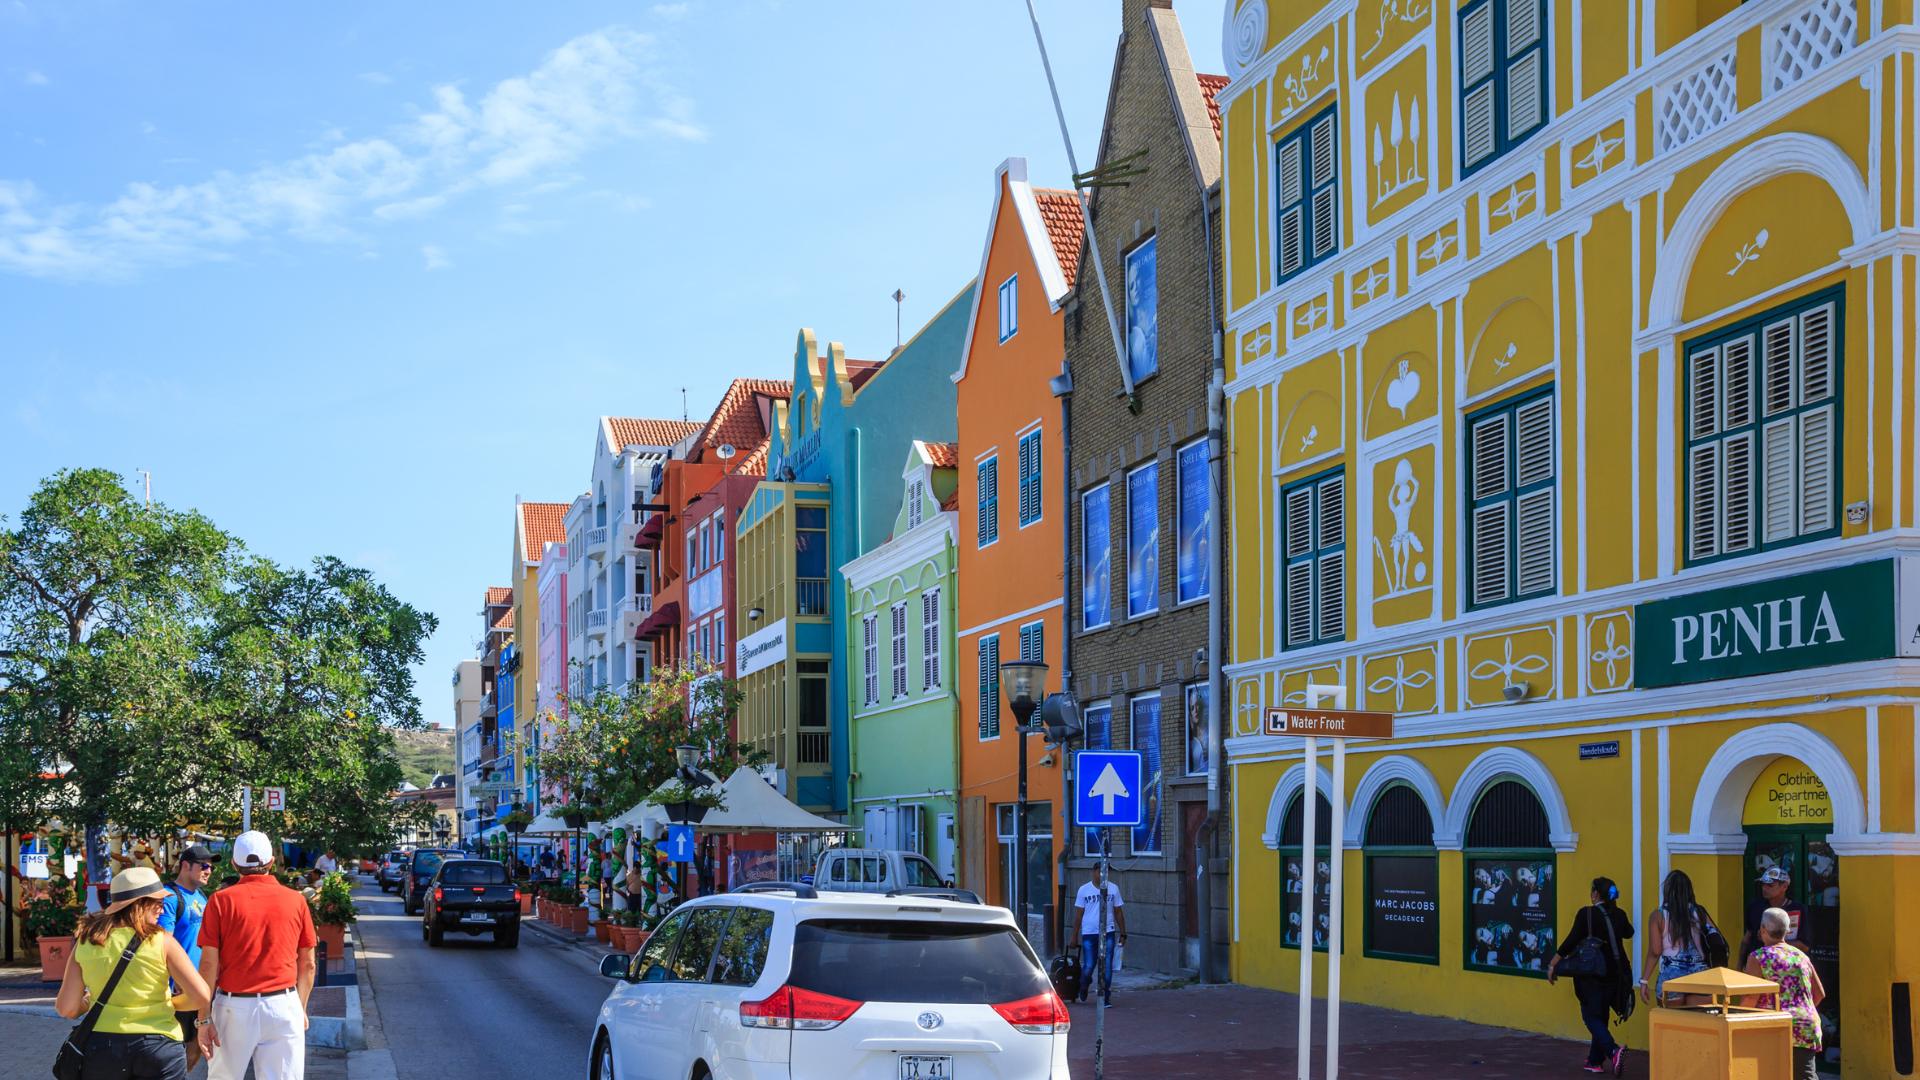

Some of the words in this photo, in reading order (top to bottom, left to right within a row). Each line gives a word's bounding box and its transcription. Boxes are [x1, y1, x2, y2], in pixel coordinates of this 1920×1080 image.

[1672, 590, 1845, 665] PENHA
[1291, 715, 1318, 729] Water
[1320, 717, 1345, 730] Front
[1580, 745, 1617, 756] Handelskade
[1778, 772, 1823, 788] Clothing
[268, 791, 280, 807] B
[1778, 805, 1796, 818] 1st.
[1799, 804, 1828, 817] Floor
[1375, 899, 1398, 909] MARC
[1400, 901, 1435, 911] JACOBS
[1385, 914, 1425, 923] DECADENCE
[906, 1062, 919, 1077] TX
[930, 1062, 942, 1077] 41
